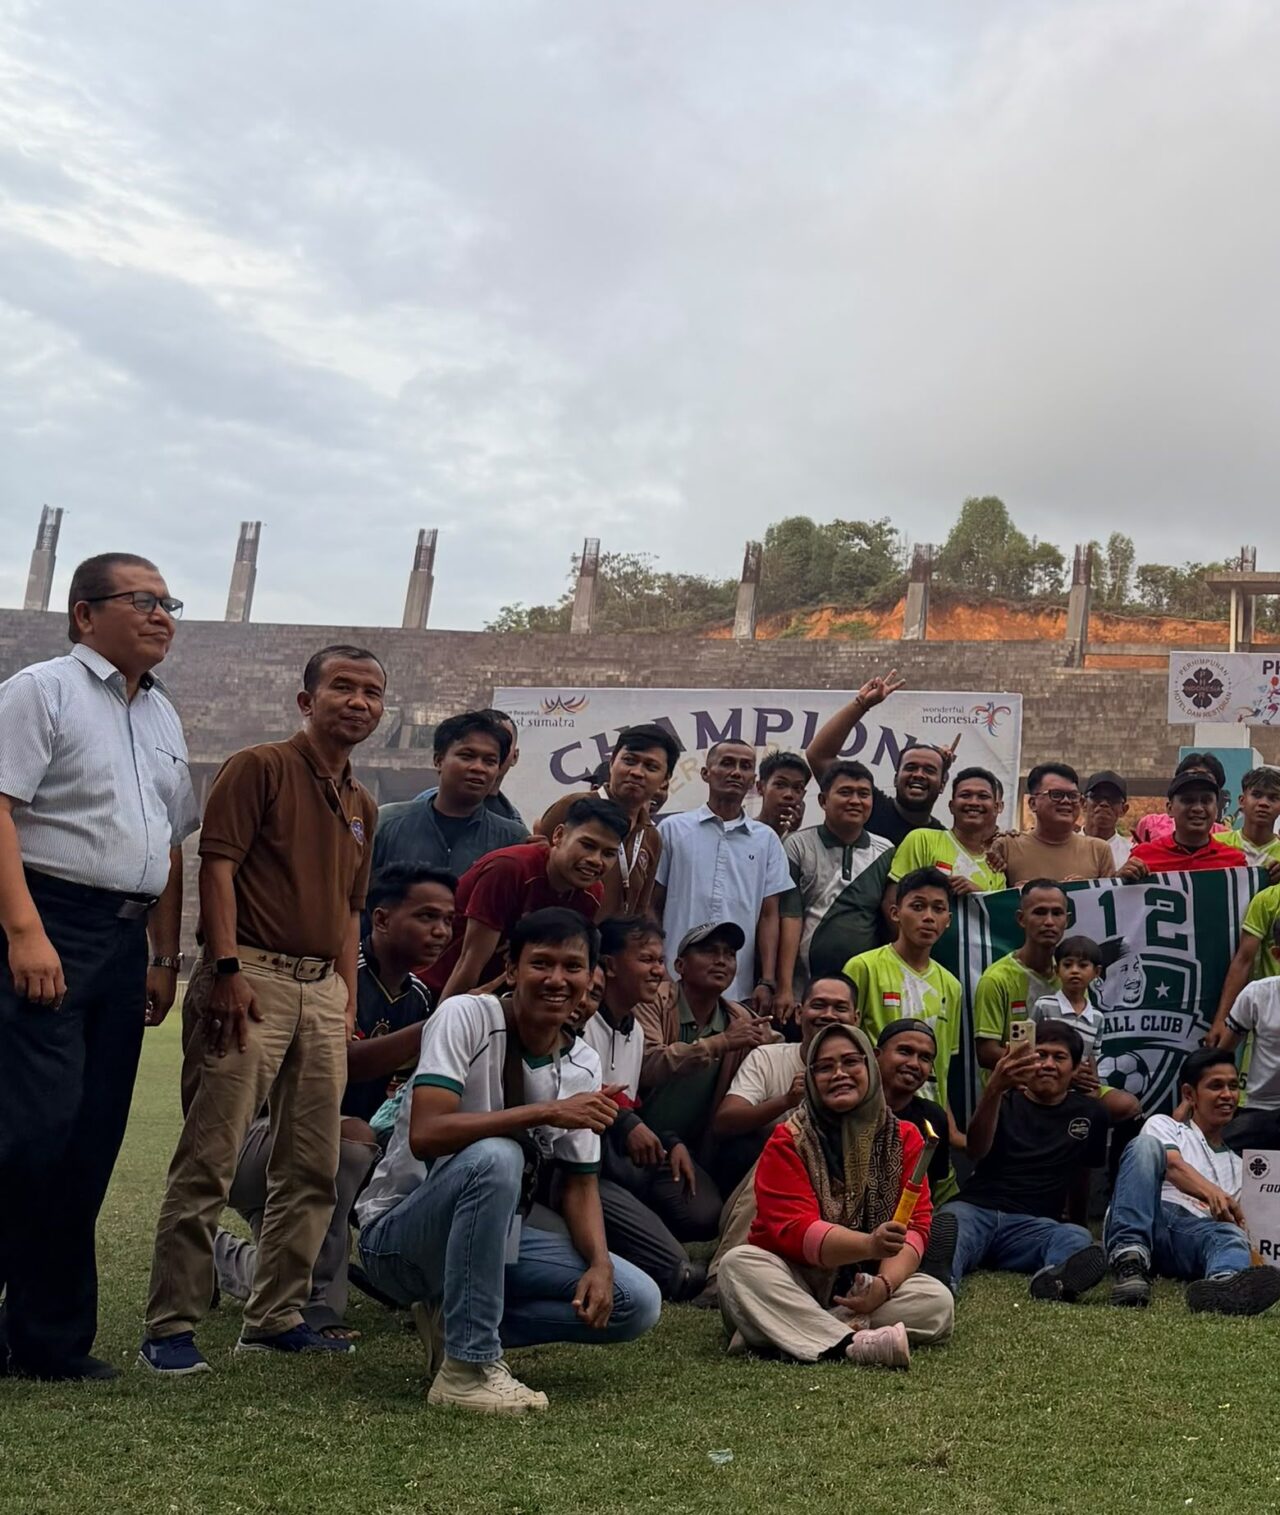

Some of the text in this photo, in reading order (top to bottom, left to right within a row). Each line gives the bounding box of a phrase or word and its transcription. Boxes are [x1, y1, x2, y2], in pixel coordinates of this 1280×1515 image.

[922, 705, 965, 714] wonderful
[922, 712, 978, 725] indonesia
[1141, 1015, 1183, 1034] CLUB
